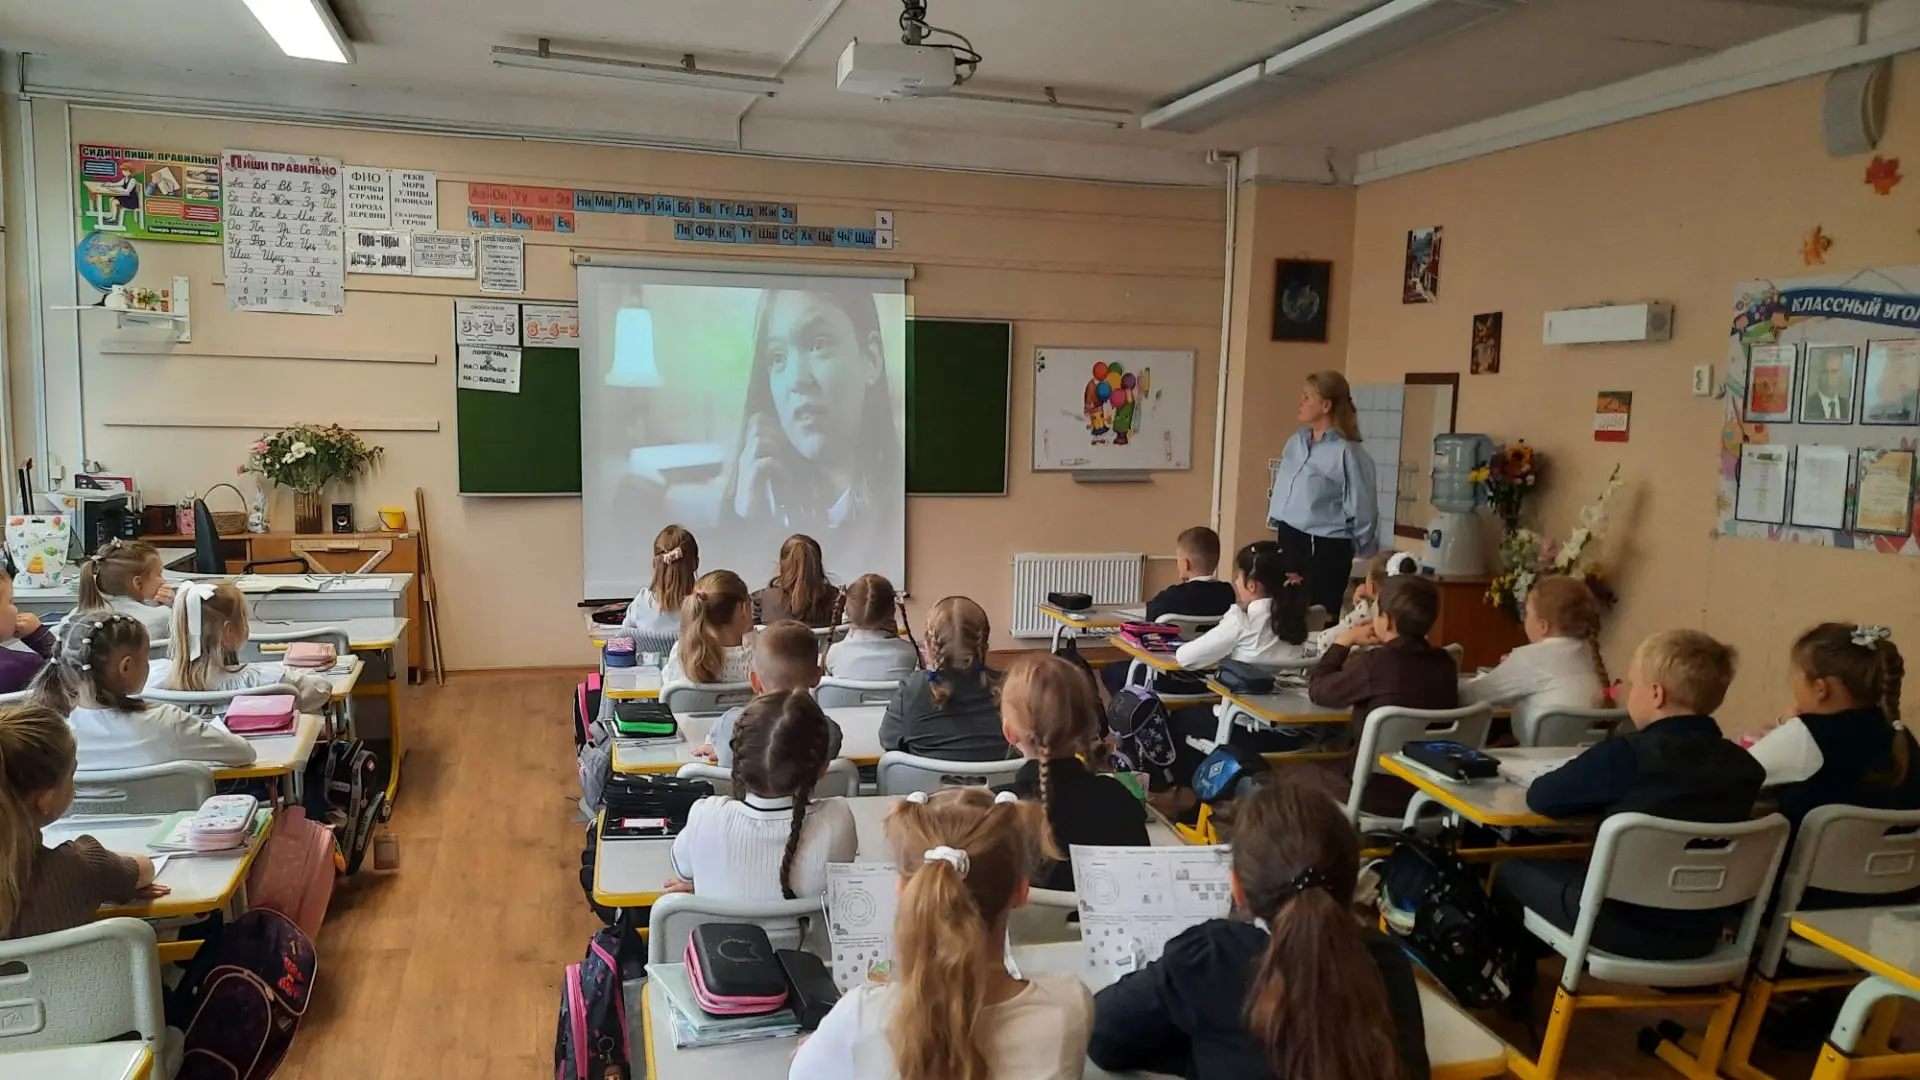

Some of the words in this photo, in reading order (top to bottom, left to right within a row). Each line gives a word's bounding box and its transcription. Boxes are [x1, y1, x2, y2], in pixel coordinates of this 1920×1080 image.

[83, 147, 111, 157] СИДИ
[113, 150, 120, 158] И
[125, 150, 154, 159] ПИШИ
[158, 152, 218, 165] ПРАВИЛЬНО
[351, 172, 381, 183] ФИО
[349, 184, 384, 192] КЛИЧКИ
[349, 193, 384, 201] СТРАНЫ
[394, 198, 433, 206] ПЛОЩАДИ
[576, 194, 591, 207] Нн
[595, 196, 612, 207] Мм
[617, 198, 632, 208] Лл
[638, 198, 650, 212] Рр
[657, 197, 671, 211] Йй
[678, 202, 691, 213] Бб
[699, 203, 711, 214] Вв
[720, 204, 730, 214] Гг
[736, 205, 753, 216] Дд
[759, 205, 776, 216] Жж
[781, 208, 792, 218] Зз
[350, 203, 383, 211] ГОРОДА
[348, 211, 386, 219] ДЕРЕВНИ
[471, 211, 486, 222] Яя
[677, 224, 690, 235] Пп
[696, 224, 714, 238] Фф
[719, 227, 732, 238] Кк
[741, 227, 752, 238] Тт
[759, 228, 777, 239] Шш
[782, 229, 794, 240] Сс
[801, 230, 812, 241] Хх
[819, 231, 832, 242] Цц
[837, 232, 850, 241] Чч
[855, 231, 874, 244] Щщ
[1791, 297, 1882, 317] КЛАССНЫЙ
[480, 365, 508, 373] МЕНЬШЕ
[479, 376, 506, 384] БОЛЬШЕ
